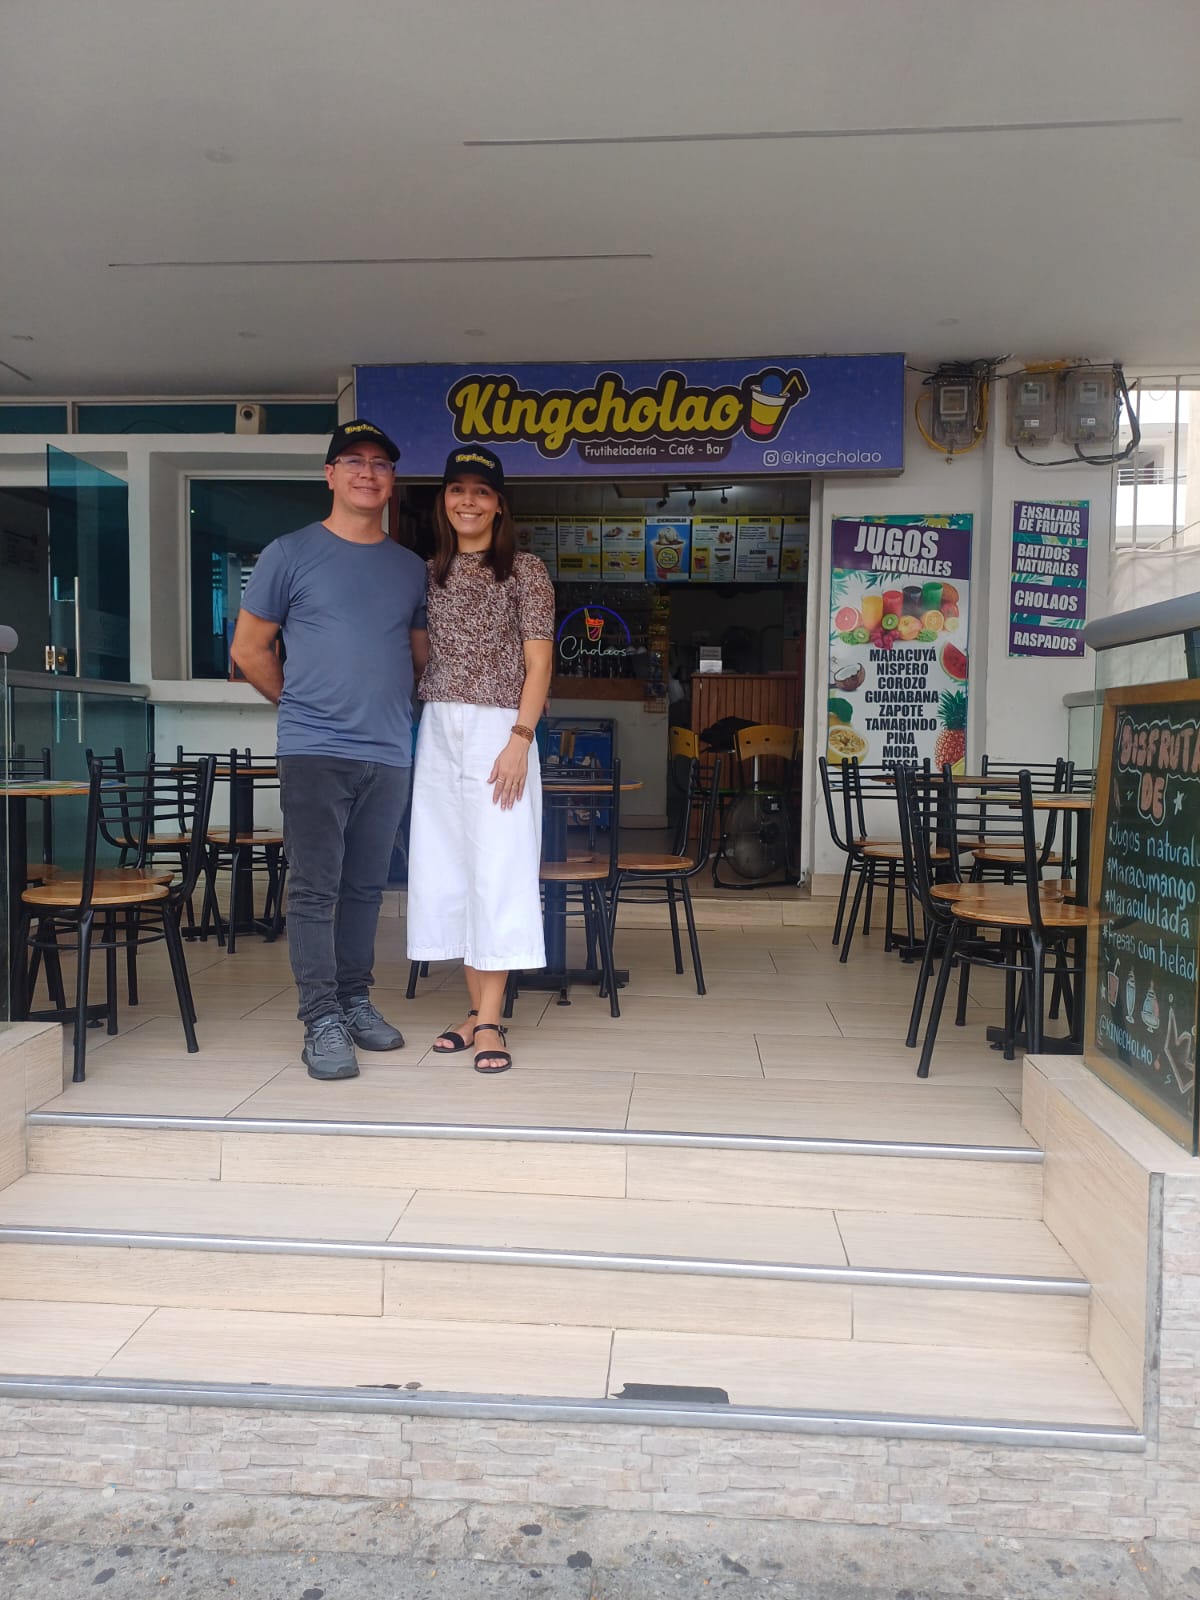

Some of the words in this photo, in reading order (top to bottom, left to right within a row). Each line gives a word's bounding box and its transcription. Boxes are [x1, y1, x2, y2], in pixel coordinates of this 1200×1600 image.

[455, 379, 743, 450] Kingcholao
[585, 444, 656, 457] Frutiheladería
[668, 443, 694, 456] Café
[706, 443, 724, 455] Bar
[781, 450, 881, 466] @kingcholao
[1021, 505, 1080, 523] ENSALADA
[1019, 518, 1033, 532] DE
[1036, 519, 1080, 536] FRUTAS
[854, 525, 939, 559] JUGOS
[1017, 543, 1070, 561] BATIDOS
[872, 555, 952, 577] NATURALES
[1016, 558, 1079, 577] NATURALES
[1014, 590, 1078, 612] CHOLAOS
[560, 635, 627, 660] Cholaos
[1014, 631, 1077, 652] RASPADOS
[870, 646, 936, 662] MARACUYÁ
[878, 677, 926, 690] COROZO
[879, 704, 923, 717] ZAPOTE
[865, 718, 937, 731] TAMARINDO
[883, 746, 918, 758] MORA
[1141, 772, 1165, 819] DE
[1138, 940, 1155, 964] con
